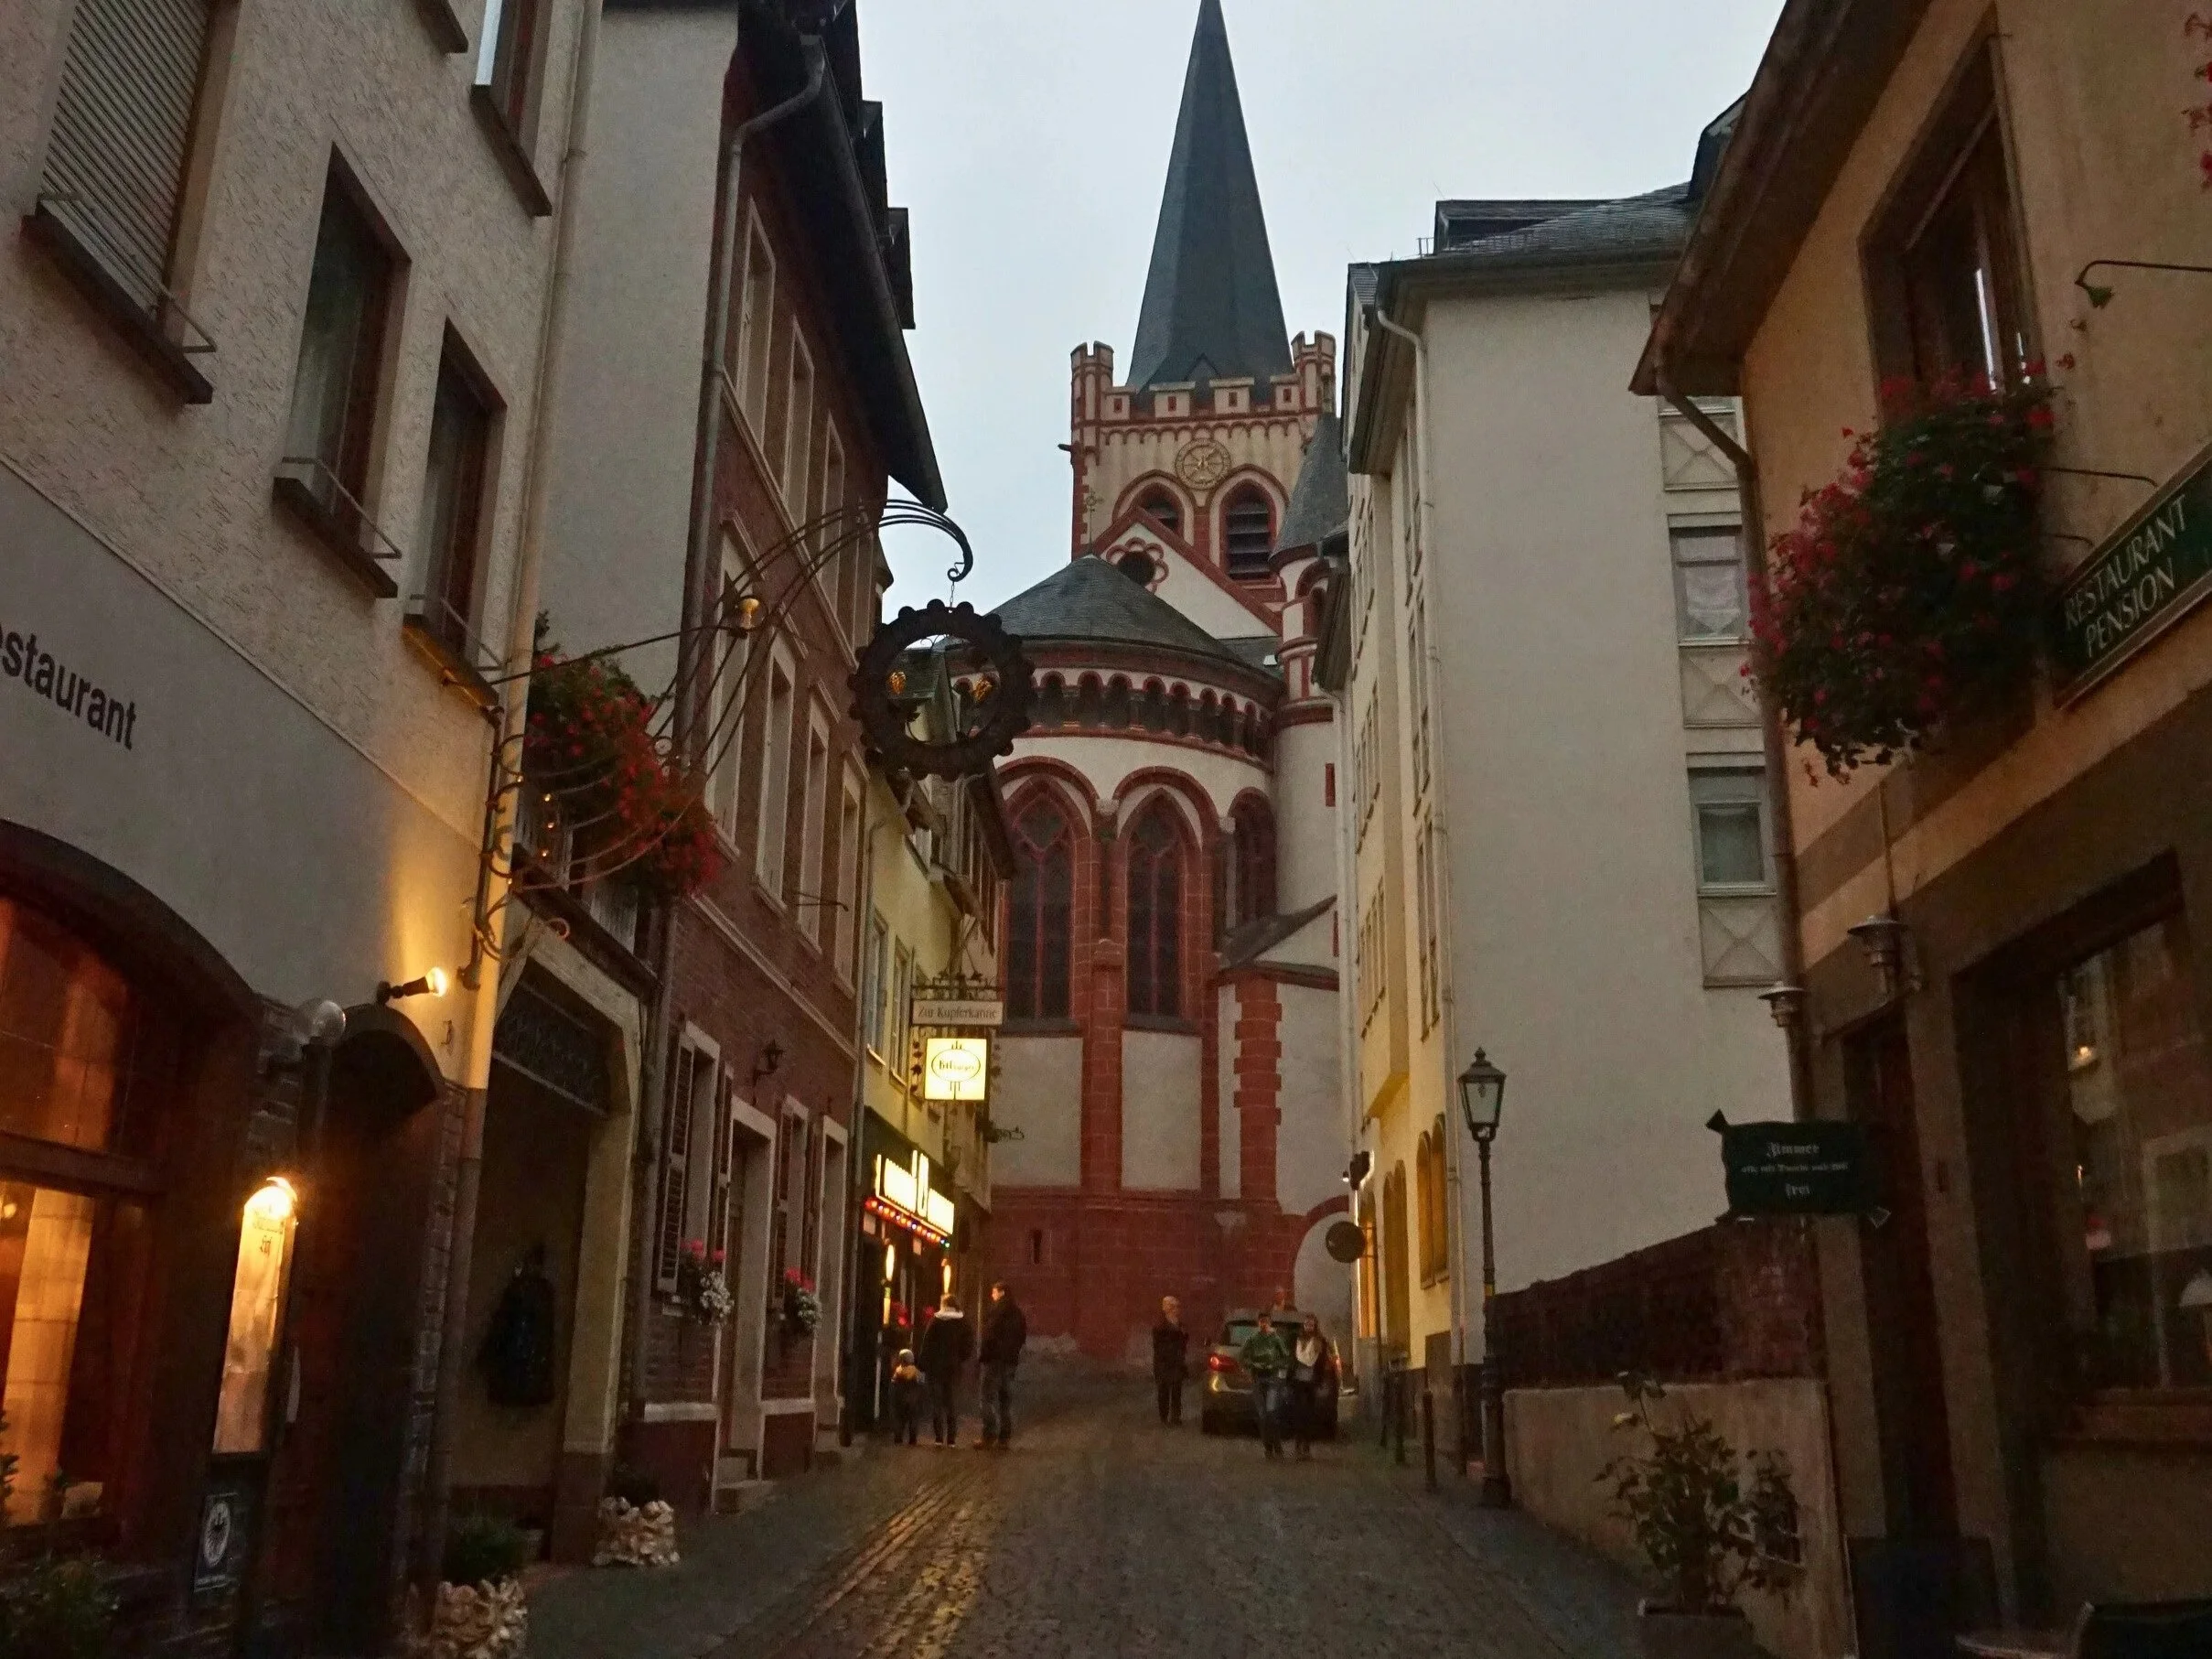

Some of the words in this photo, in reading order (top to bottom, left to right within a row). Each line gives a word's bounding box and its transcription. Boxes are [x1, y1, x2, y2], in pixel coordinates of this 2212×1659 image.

[2064, 493, 2187, 630] RESTAURANT
[2085, 555, 2175, 658] PENSION
[0, 622, 136, 750] staurant
